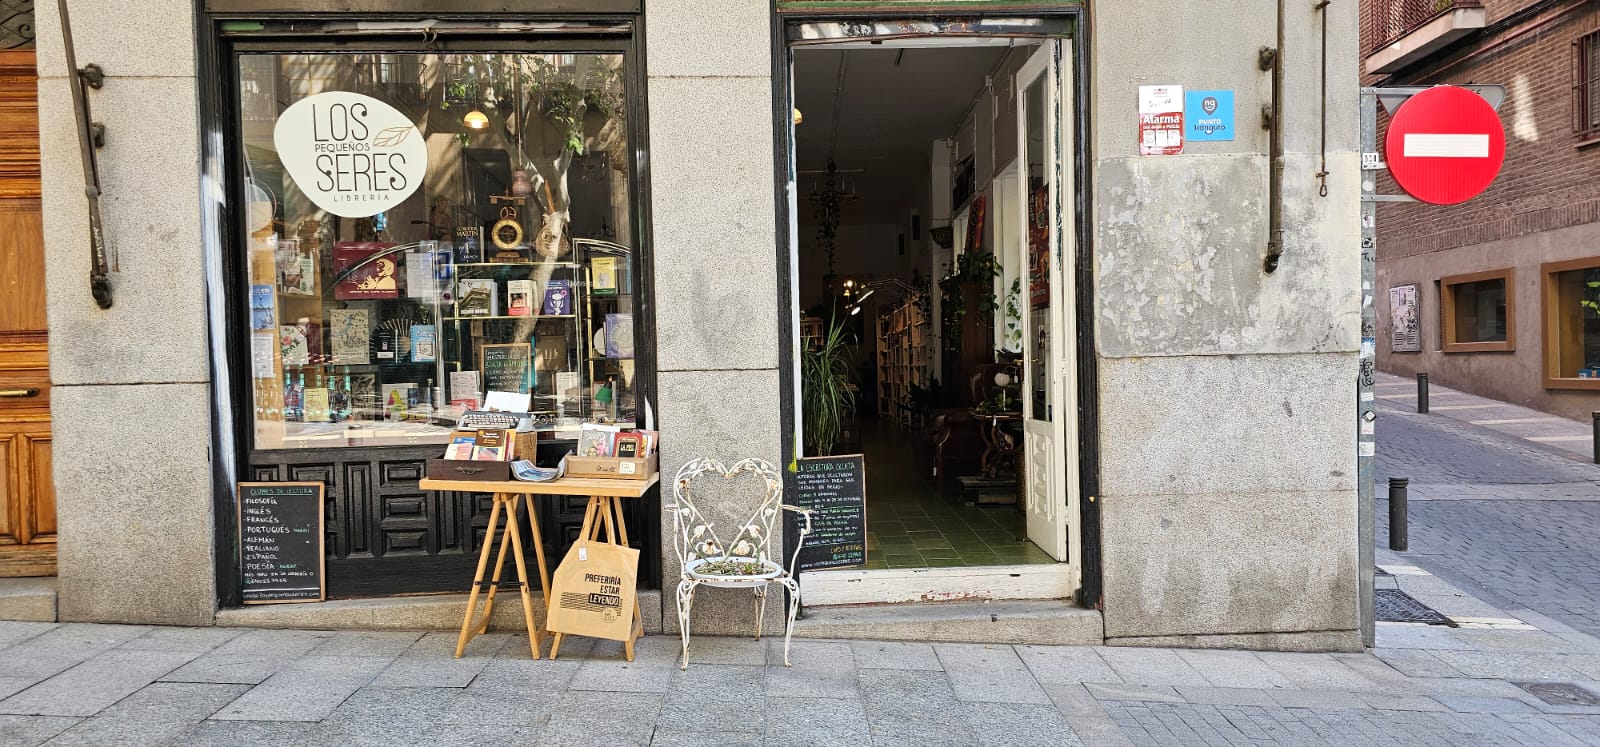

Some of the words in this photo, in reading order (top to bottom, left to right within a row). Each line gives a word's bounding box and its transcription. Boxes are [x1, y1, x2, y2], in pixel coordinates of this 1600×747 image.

[313, 103, 369, 142] LOS
[1143, 115, 1180, 124] Alarma
[1194, 124, 1226, 135] kanguro
[315, 141, 370, 153] PEQUEÑOS
[316, 153, 407, 192] SERES
[333, 193, 390, 202] LIBRERÍA
[585, 573, 621, 586] PREFERIRÍA
[600, 585, 620, 595] ESTAR
[589, 594, 619, 606] LEYENDO
